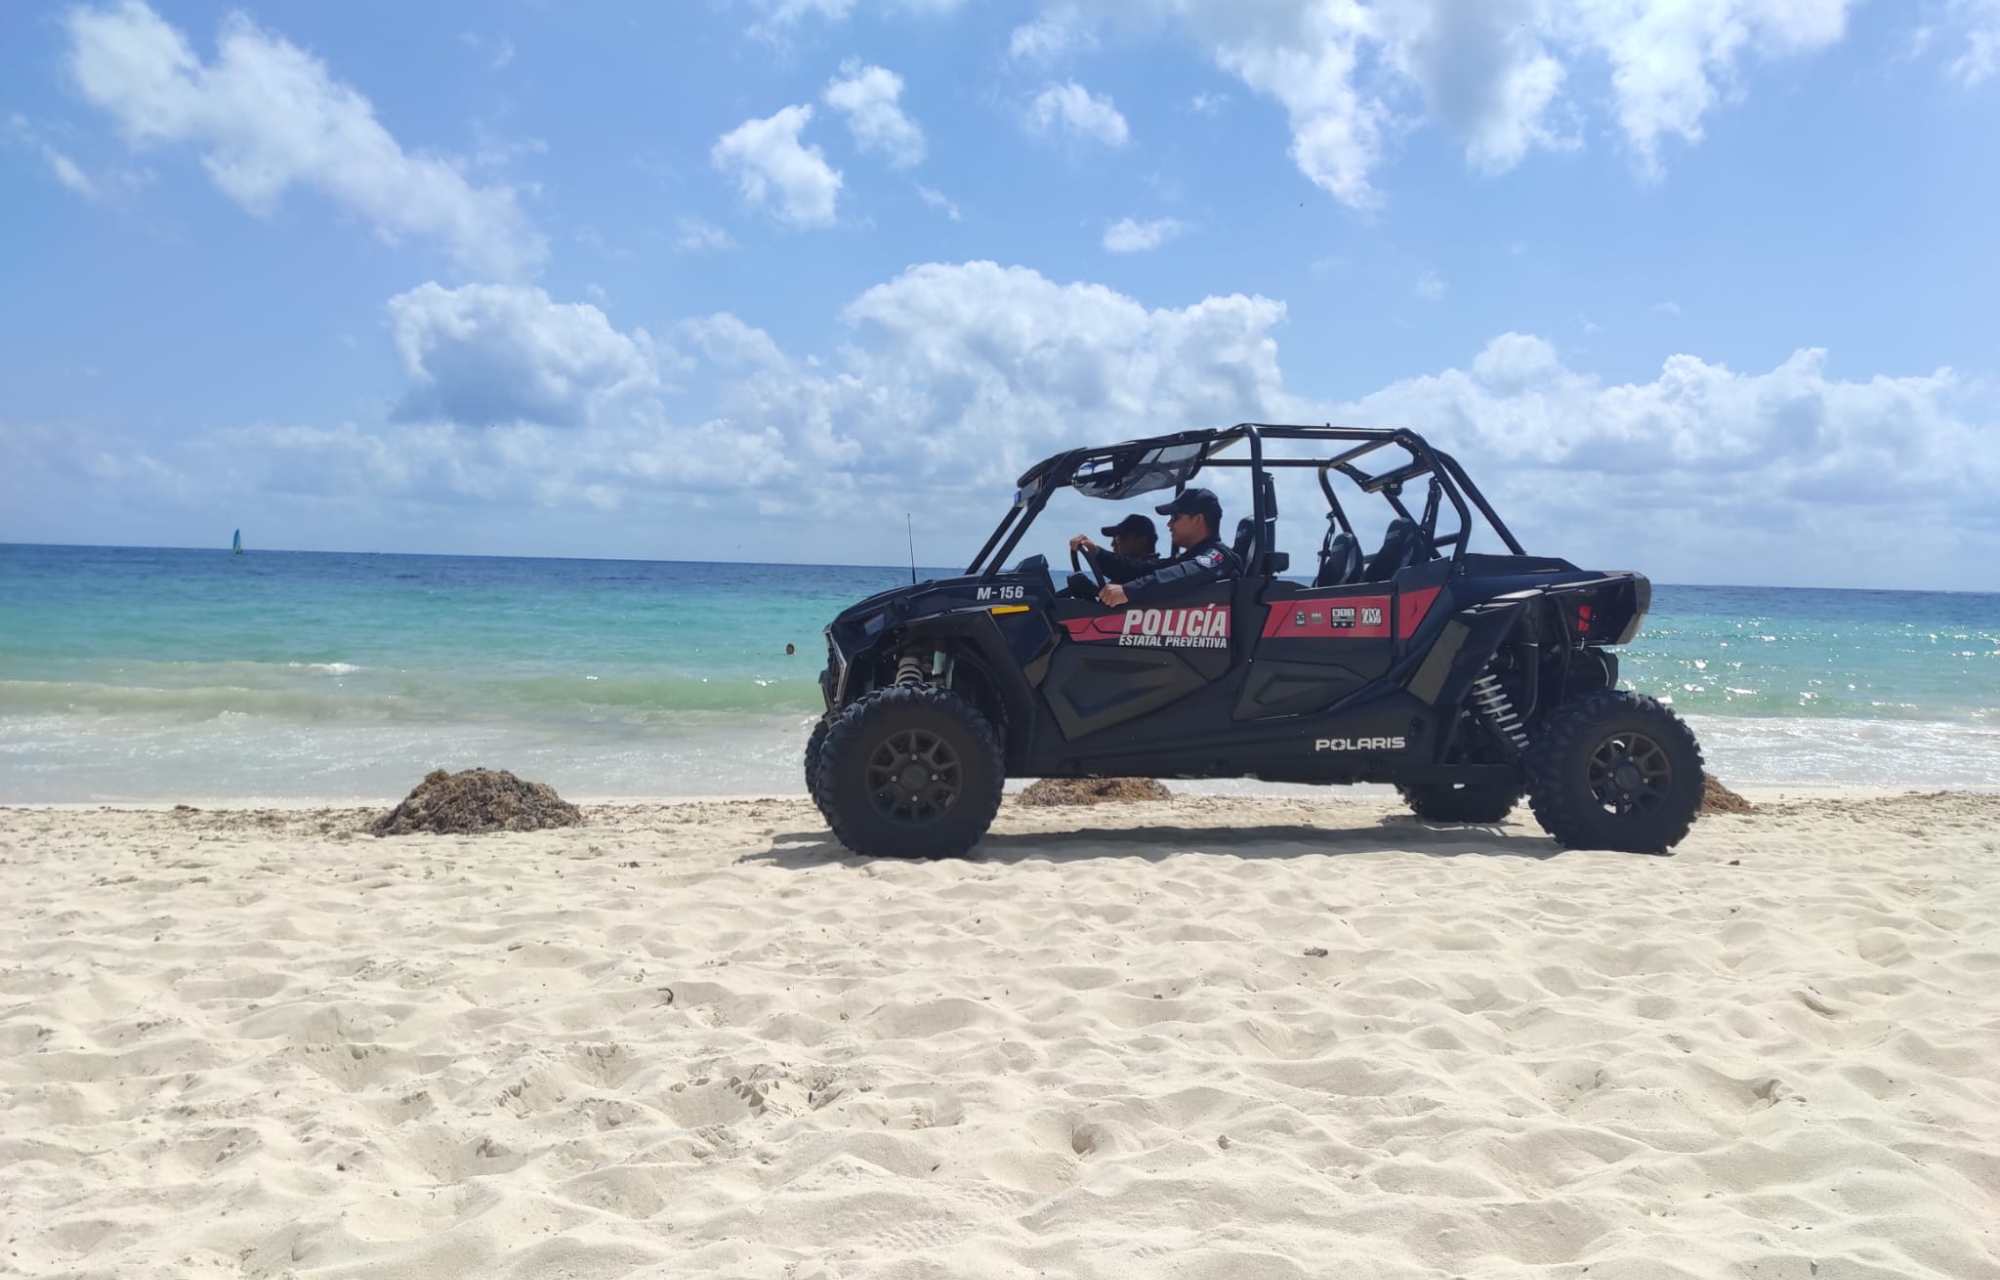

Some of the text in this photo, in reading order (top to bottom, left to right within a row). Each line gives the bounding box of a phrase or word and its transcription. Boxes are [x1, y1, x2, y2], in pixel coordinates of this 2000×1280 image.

[976, 585, 1024, 600] M-156
[1122, 604, 1227, 637] POLICÍA
[1119, 635, 1228, 649] ESTATAL PREVENTIVA
[1315, 737, 1406, 751] POLARIS
